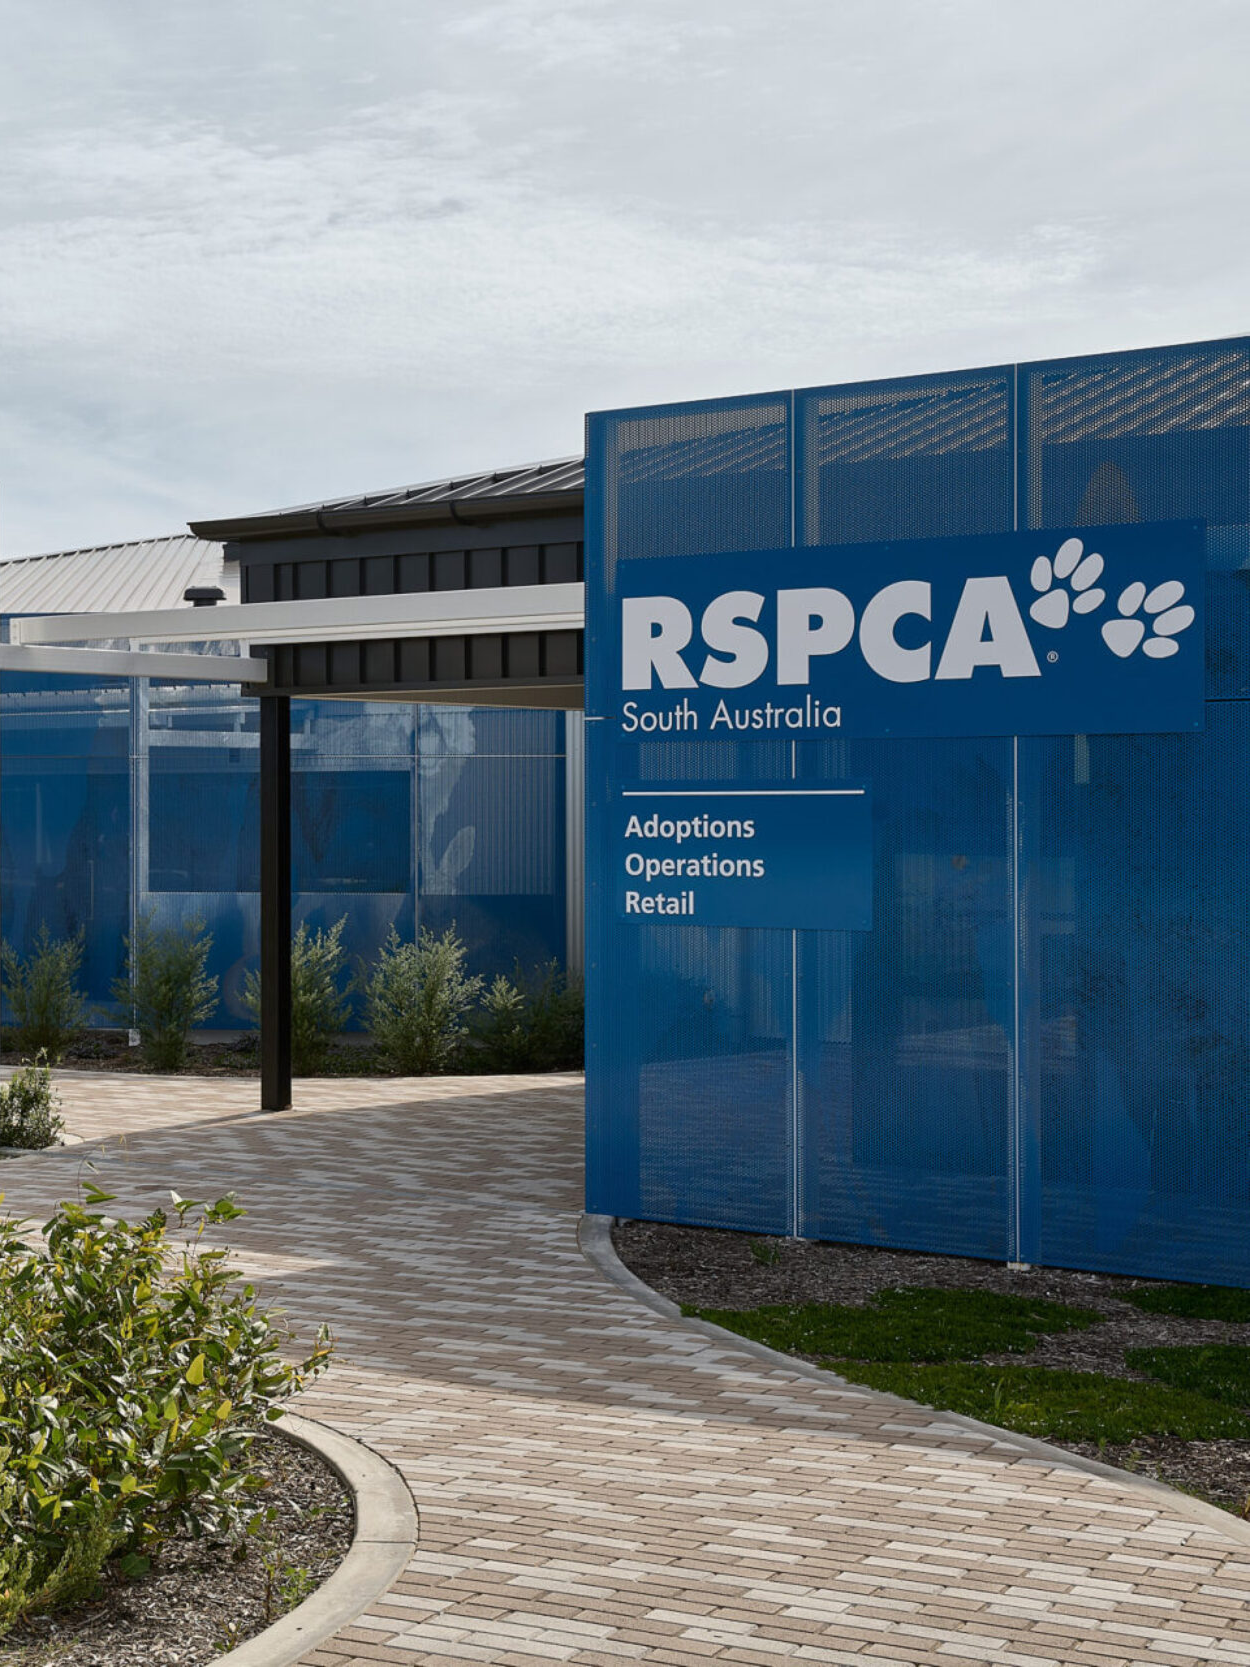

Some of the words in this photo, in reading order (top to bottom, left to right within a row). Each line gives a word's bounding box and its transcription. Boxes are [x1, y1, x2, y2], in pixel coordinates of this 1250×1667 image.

[622, 576, 1041, 690] RSPCA
[622, 697, 698, 732] South
[709, 694, 841, 730] Australia
[624, 813, 755, 842] Adoptions
[624, 853, 765, 882] Operations
[625, 891, 695, 915] Retail
